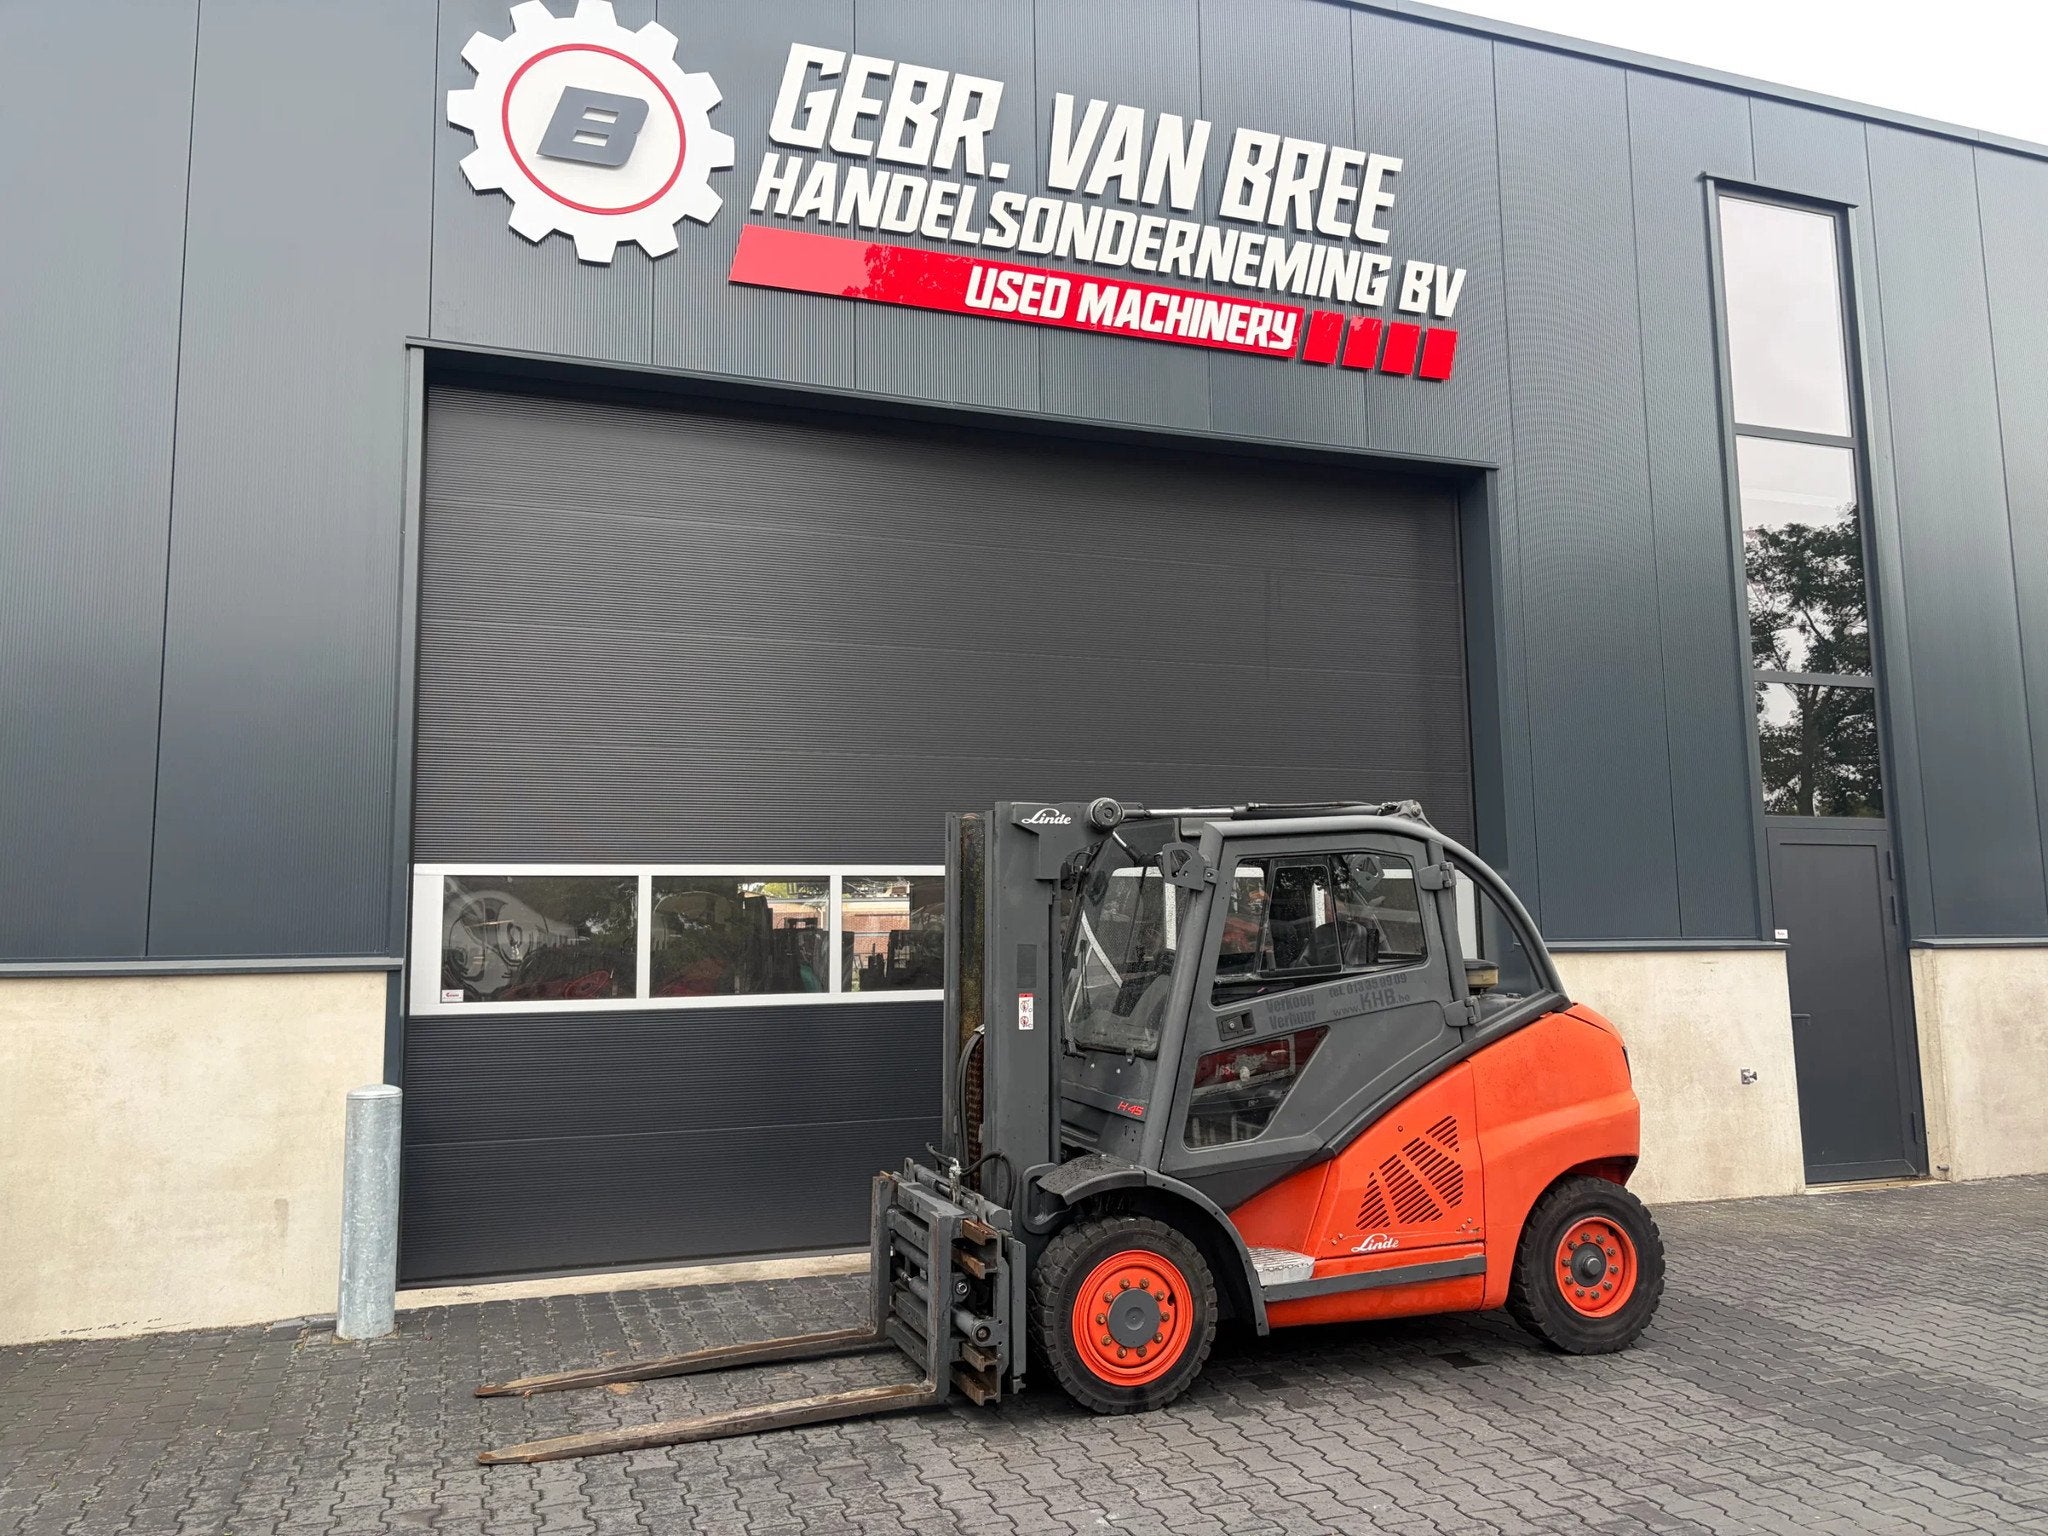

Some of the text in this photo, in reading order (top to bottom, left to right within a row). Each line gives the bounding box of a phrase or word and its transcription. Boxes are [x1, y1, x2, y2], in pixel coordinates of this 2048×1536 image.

[769, 42, 1403, 244] GEBR. VAN BREE
[750, 151, 1467, 318] HANDELSONDERNEMING BV
[964, 265, 1298, 351] USED MACHINERY
[1021, 807, 1072, 825] Linde
[1350, 1232, 1400, 1253] Linde
